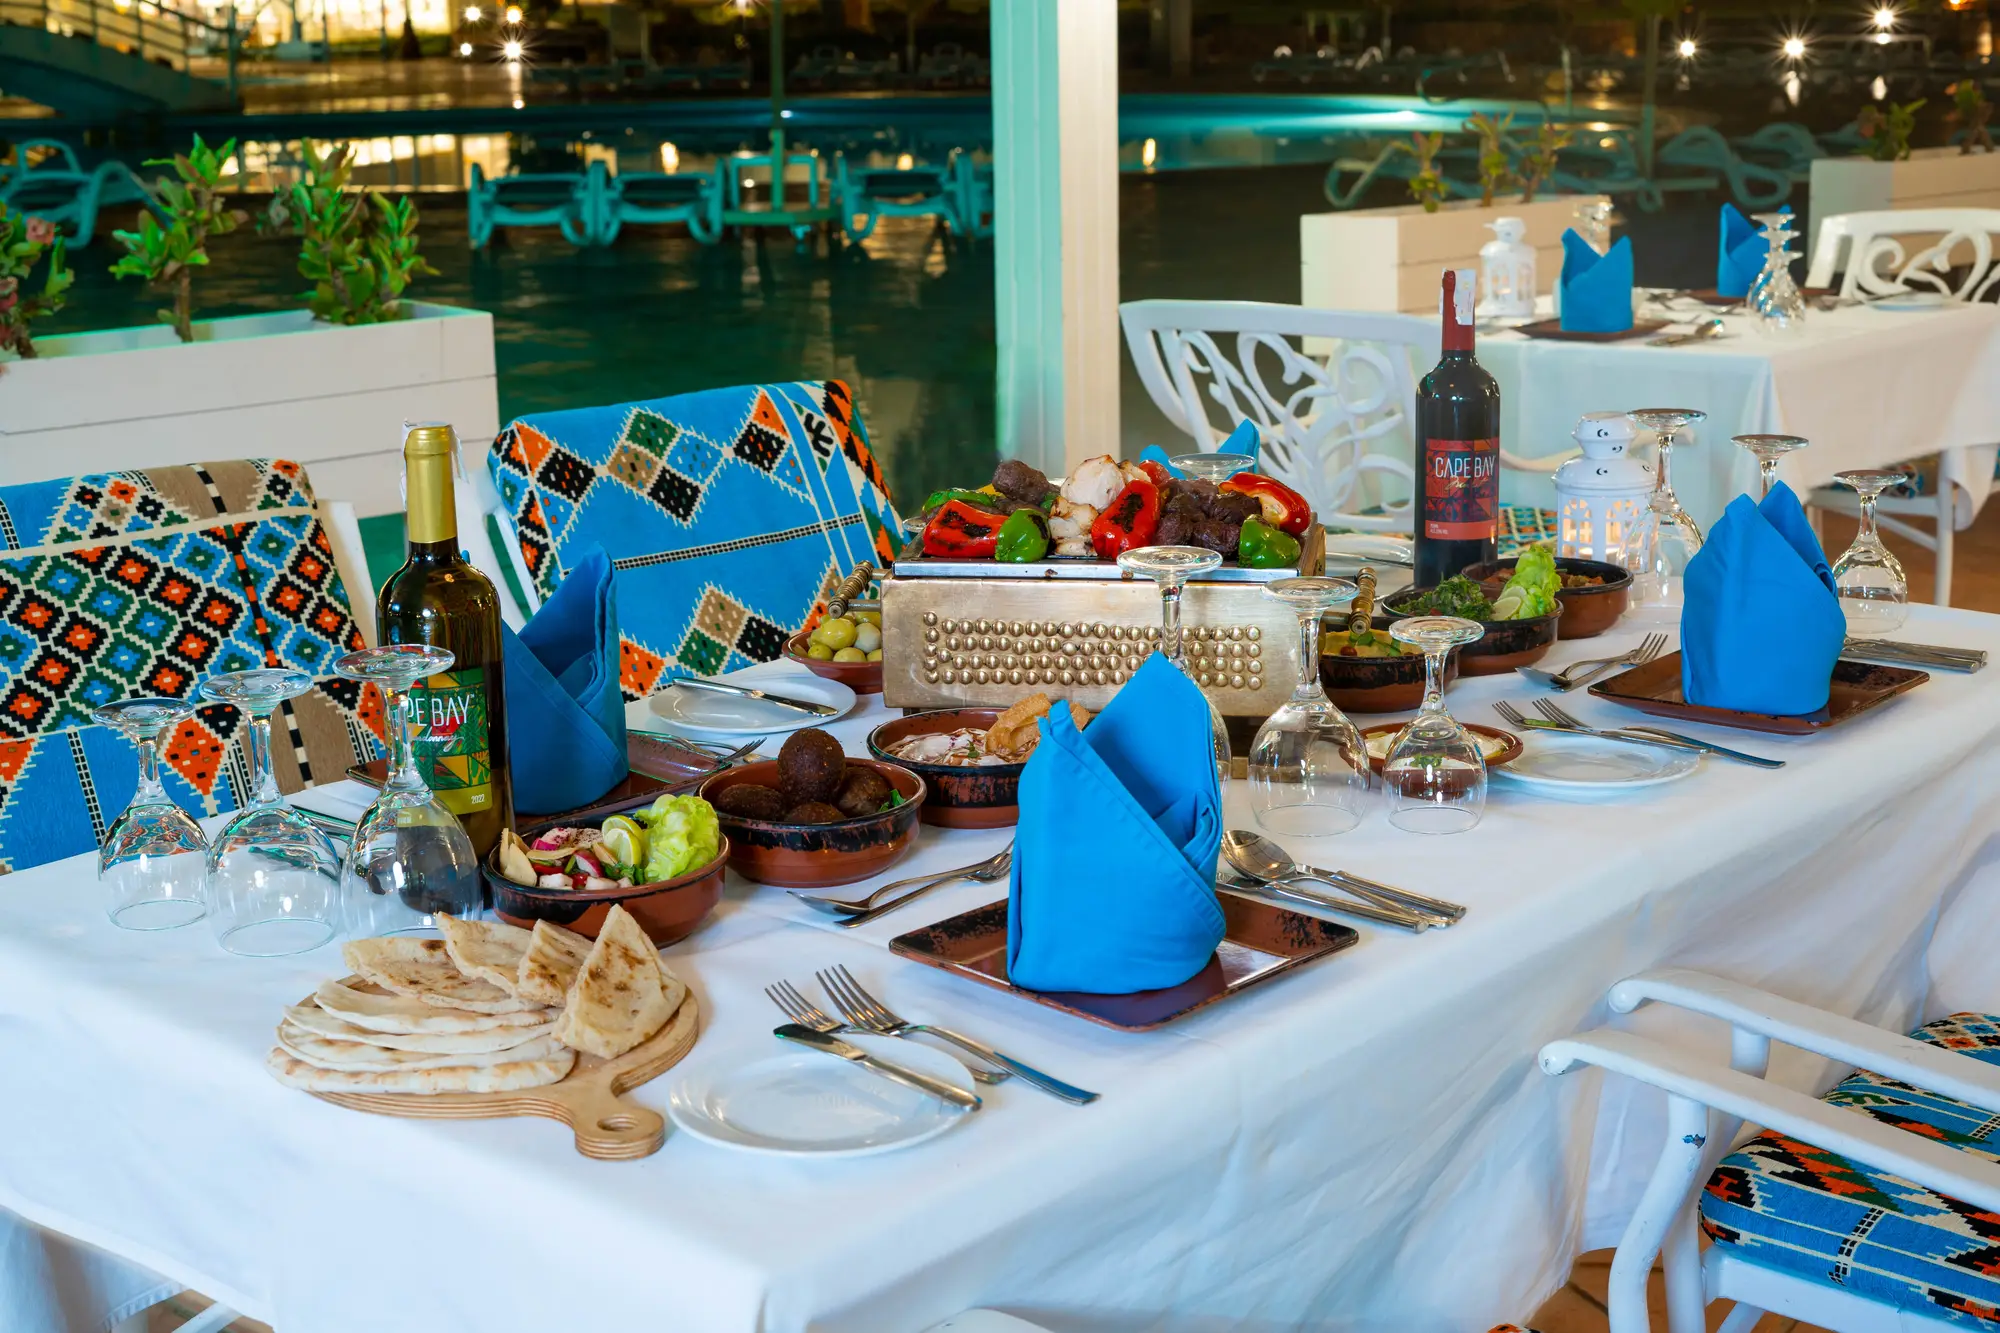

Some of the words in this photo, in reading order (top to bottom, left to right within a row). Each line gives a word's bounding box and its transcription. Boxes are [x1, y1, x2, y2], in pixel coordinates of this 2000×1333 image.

[1435, 457, 1471, 478] CAPE
[1474, 455, 1495, 478] BAY
[471, 793, 485, 804] 2022
